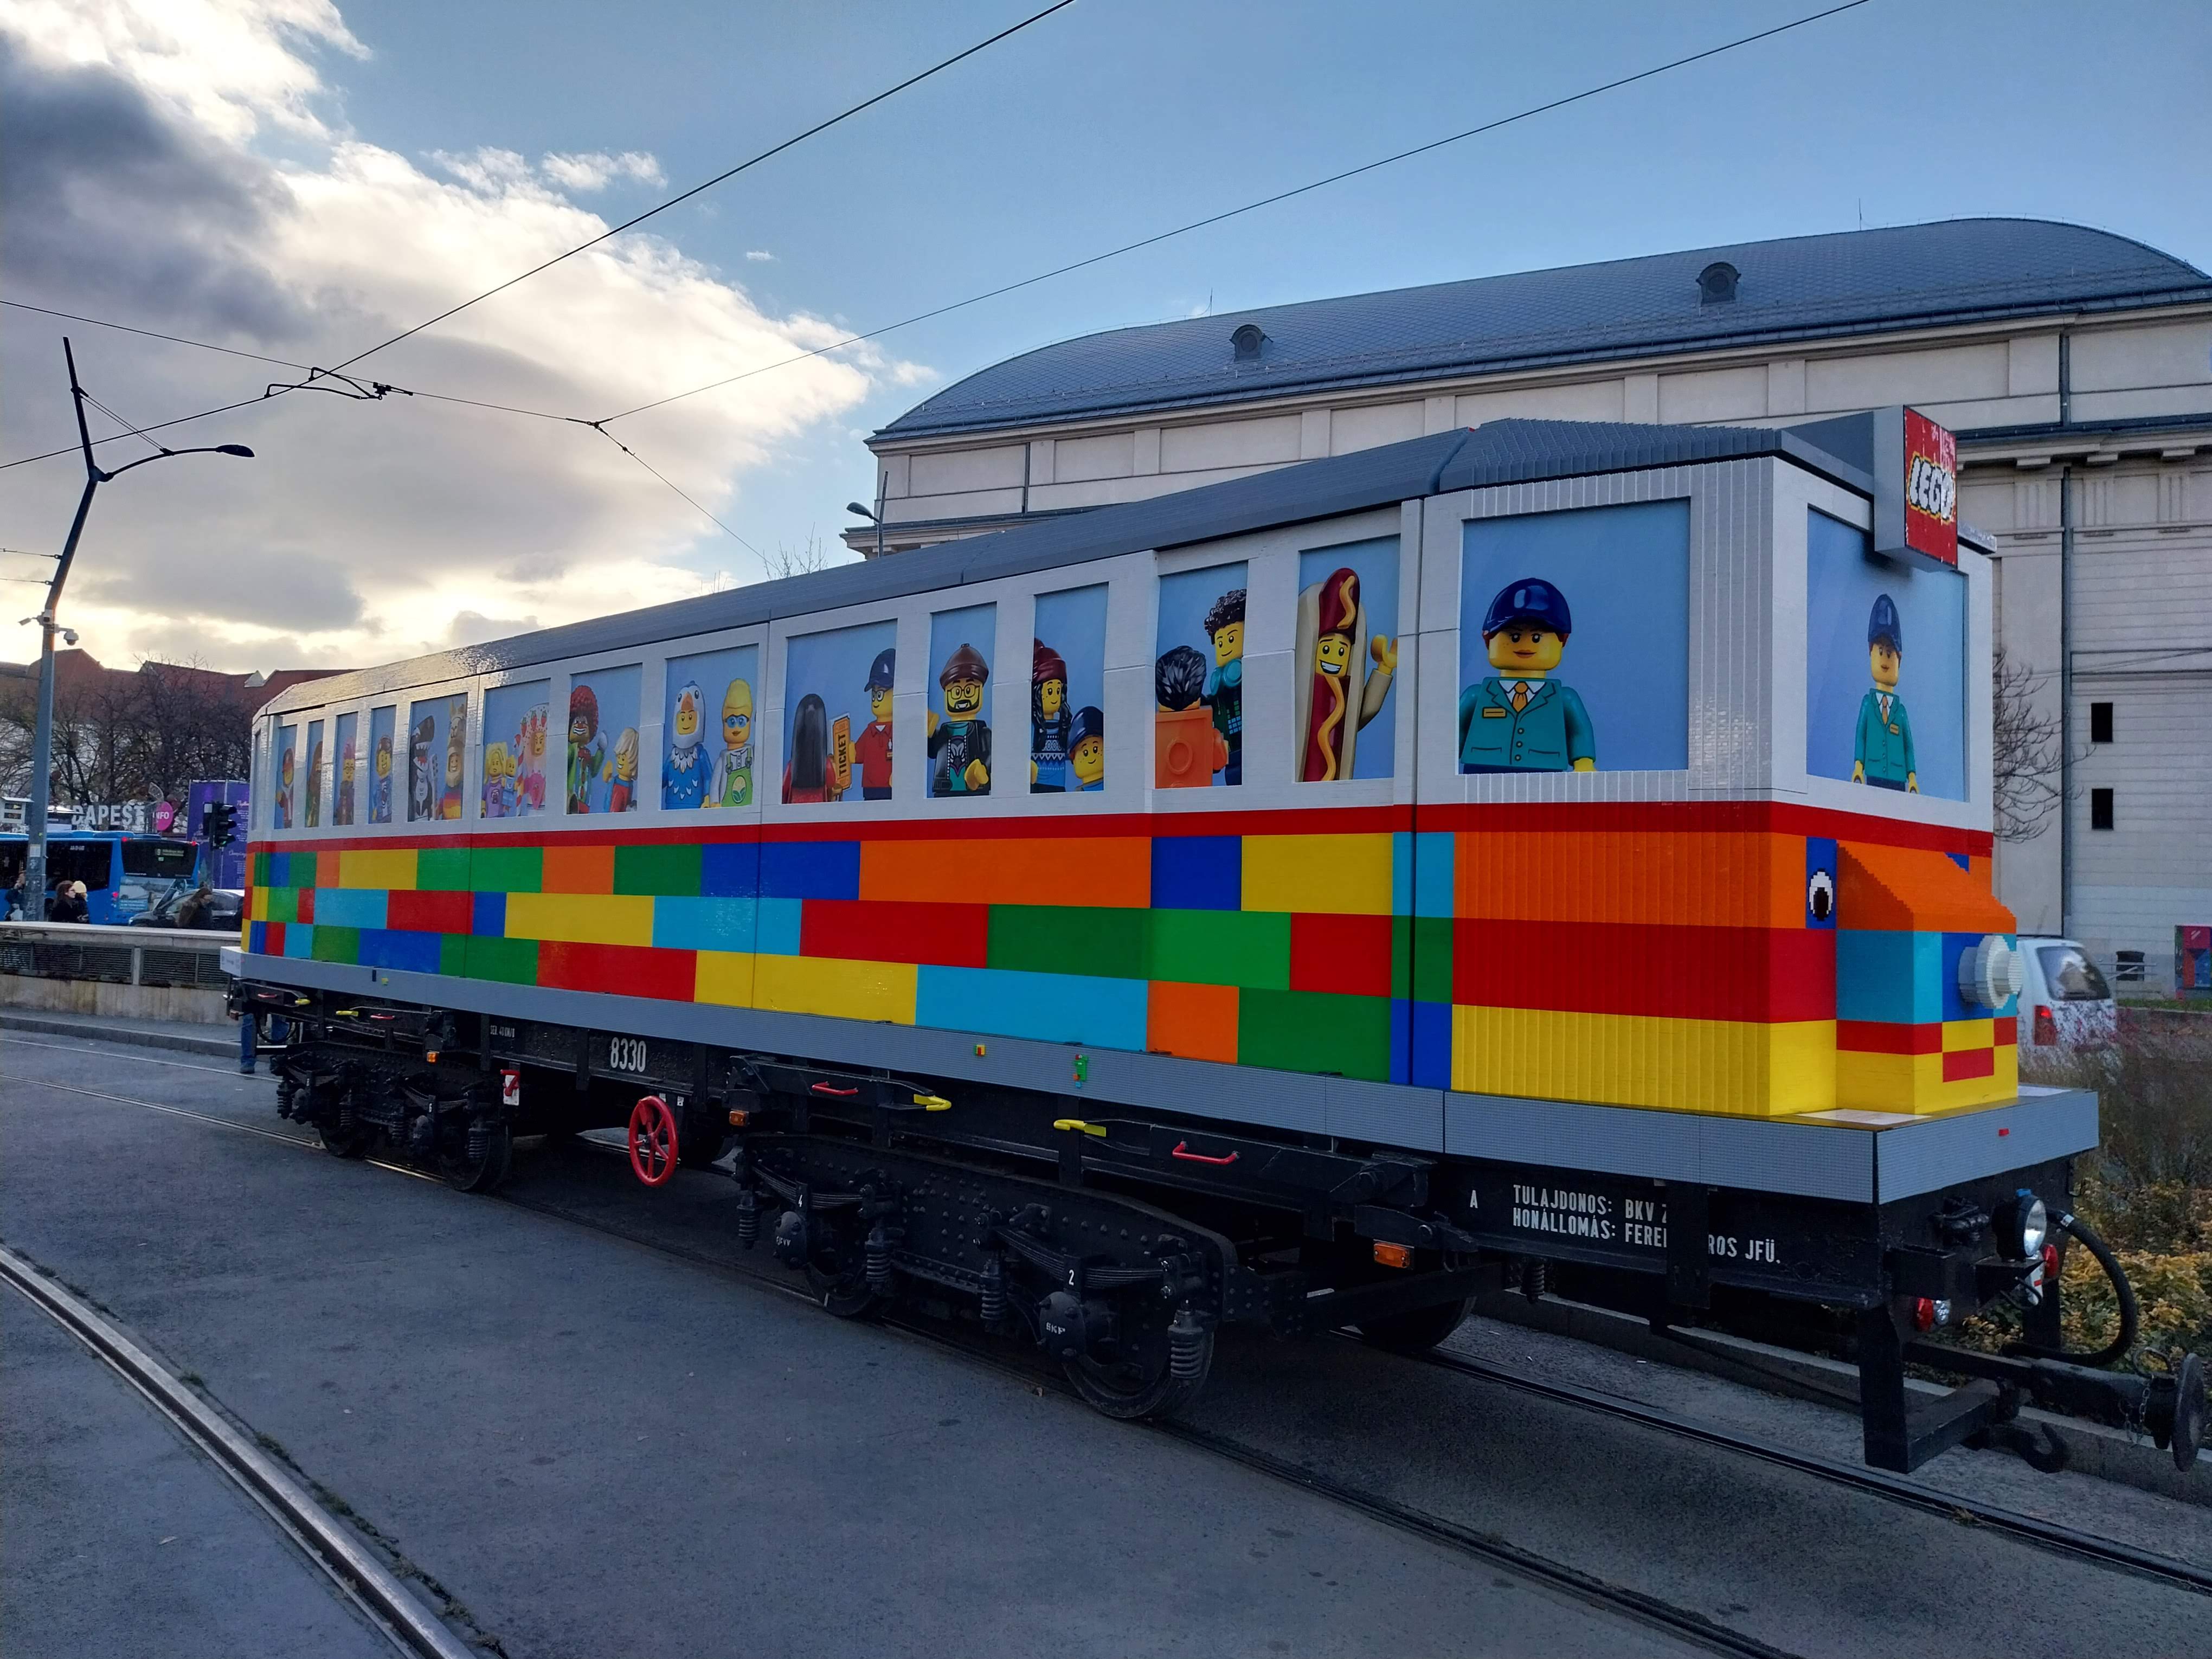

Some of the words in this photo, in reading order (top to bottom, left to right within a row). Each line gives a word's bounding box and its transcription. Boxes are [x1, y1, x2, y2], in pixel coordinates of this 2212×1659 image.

[1908, 453, 1956, 522] LEGO
[838, 734, 847, 777] TICKET
[68, 804, 145, 826] DAPEST
[610, 1037, 646, 1072] 8330
[798, 1194, 803, 1207] 4
[1470, 1189, 1478, 1208] A
[1513, 1184, 1612, 1215] TULAJDONOS:
[1625, 1199, 1654, 1221] BKV
[1513, 1207, 1616, 1239] HONÁLLOMÁS:
[1745, 1238, 1780, 1264] JFÜ.
[1069, 1269, 1075, 1286] 2
